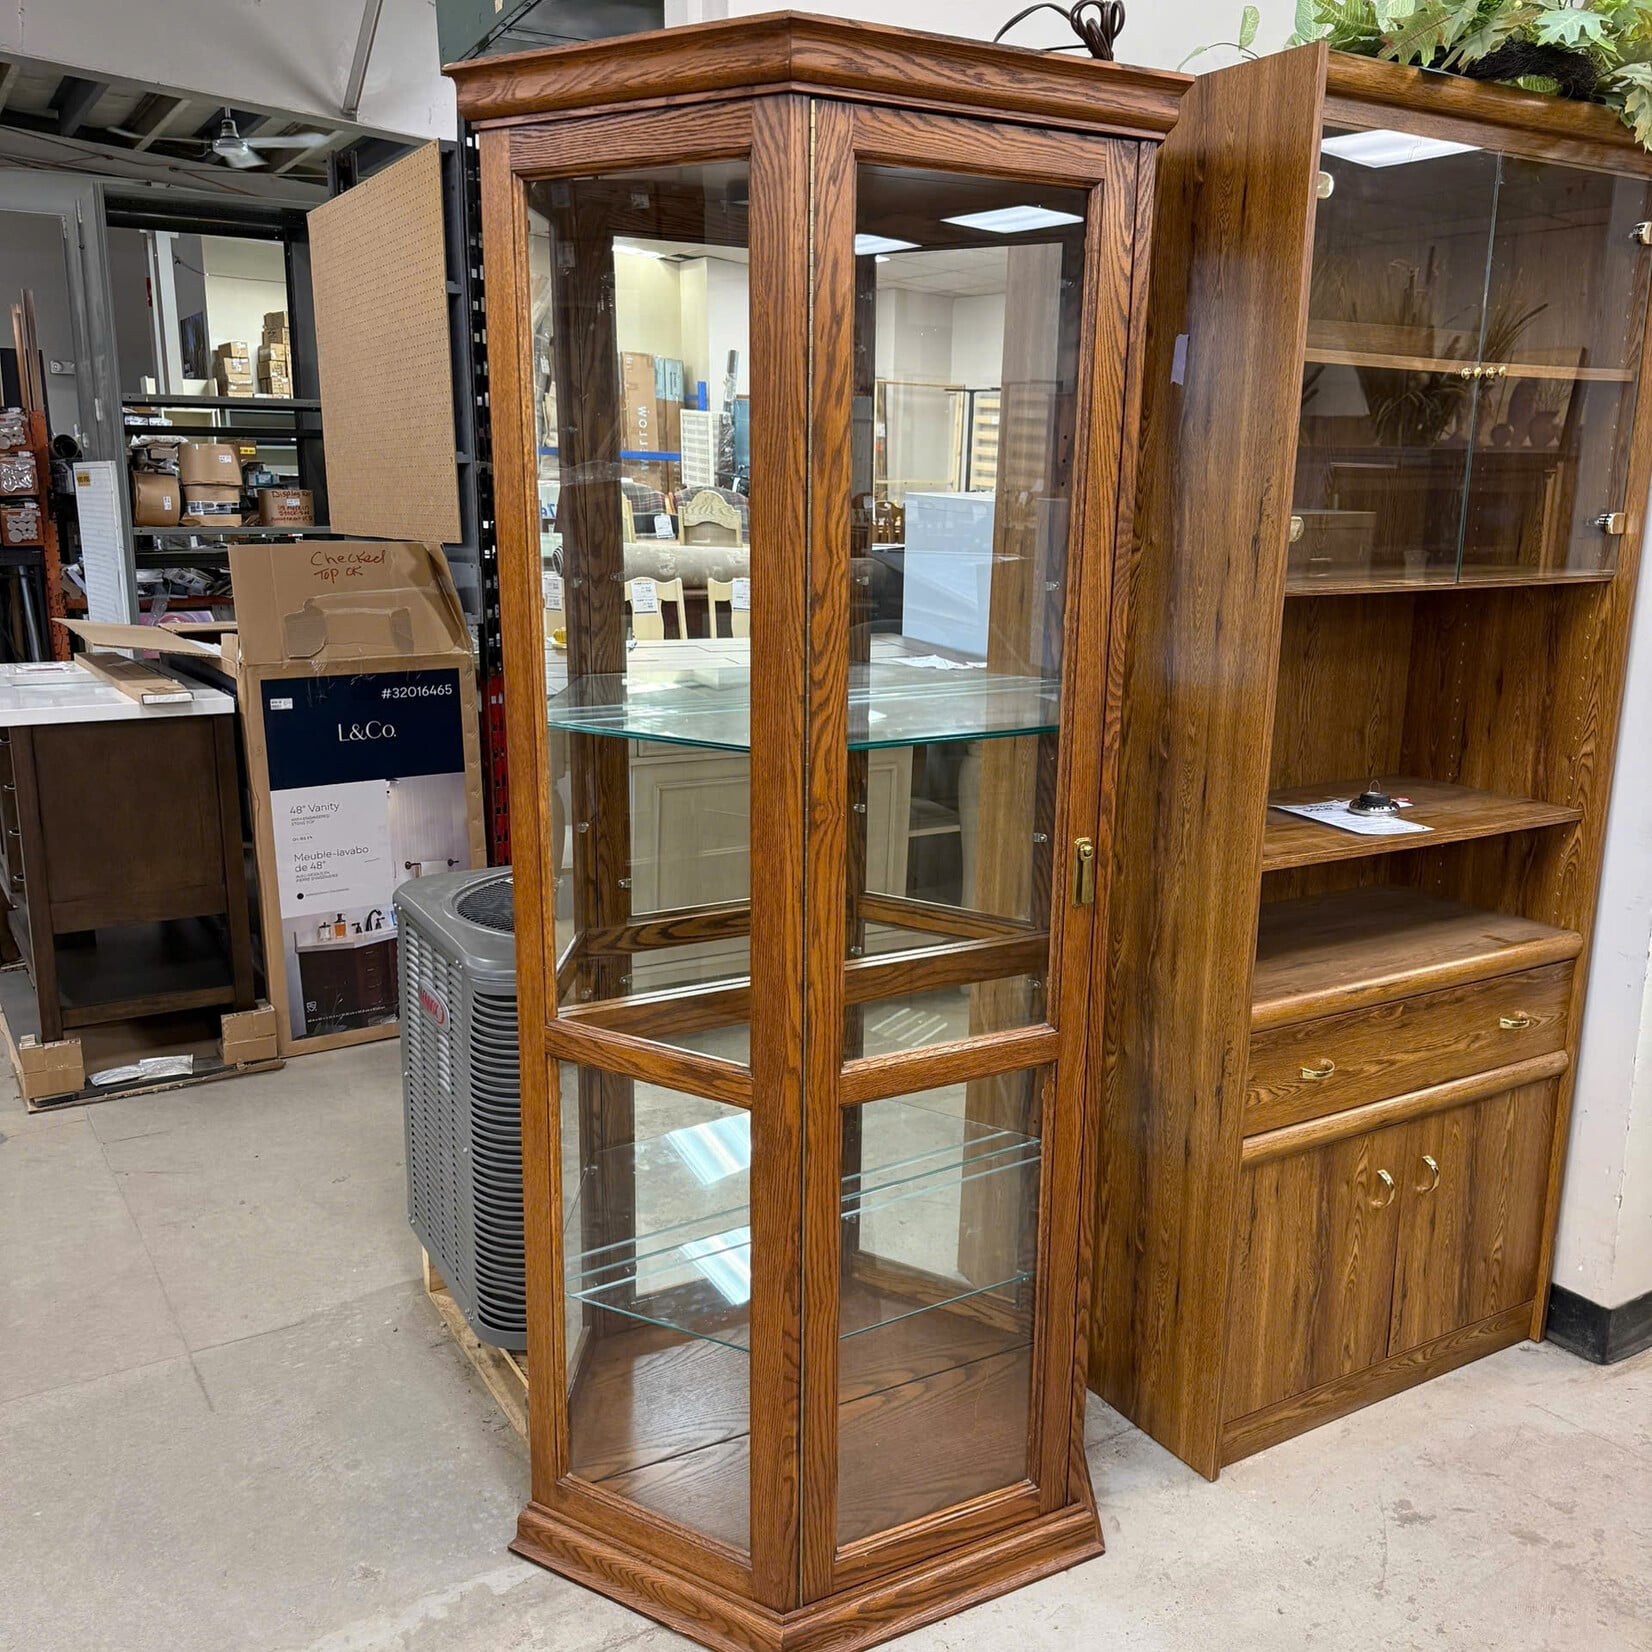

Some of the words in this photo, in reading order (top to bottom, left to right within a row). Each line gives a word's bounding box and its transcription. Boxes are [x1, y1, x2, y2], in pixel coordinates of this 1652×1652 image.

[310, 549, 386, 566] Checked
[381, 683, 453, 699] #32016465
[337, 720, 397, 742] L&Co.
[307, 803, 340, 812] Vanity
[294, 864, 308, 872] de
